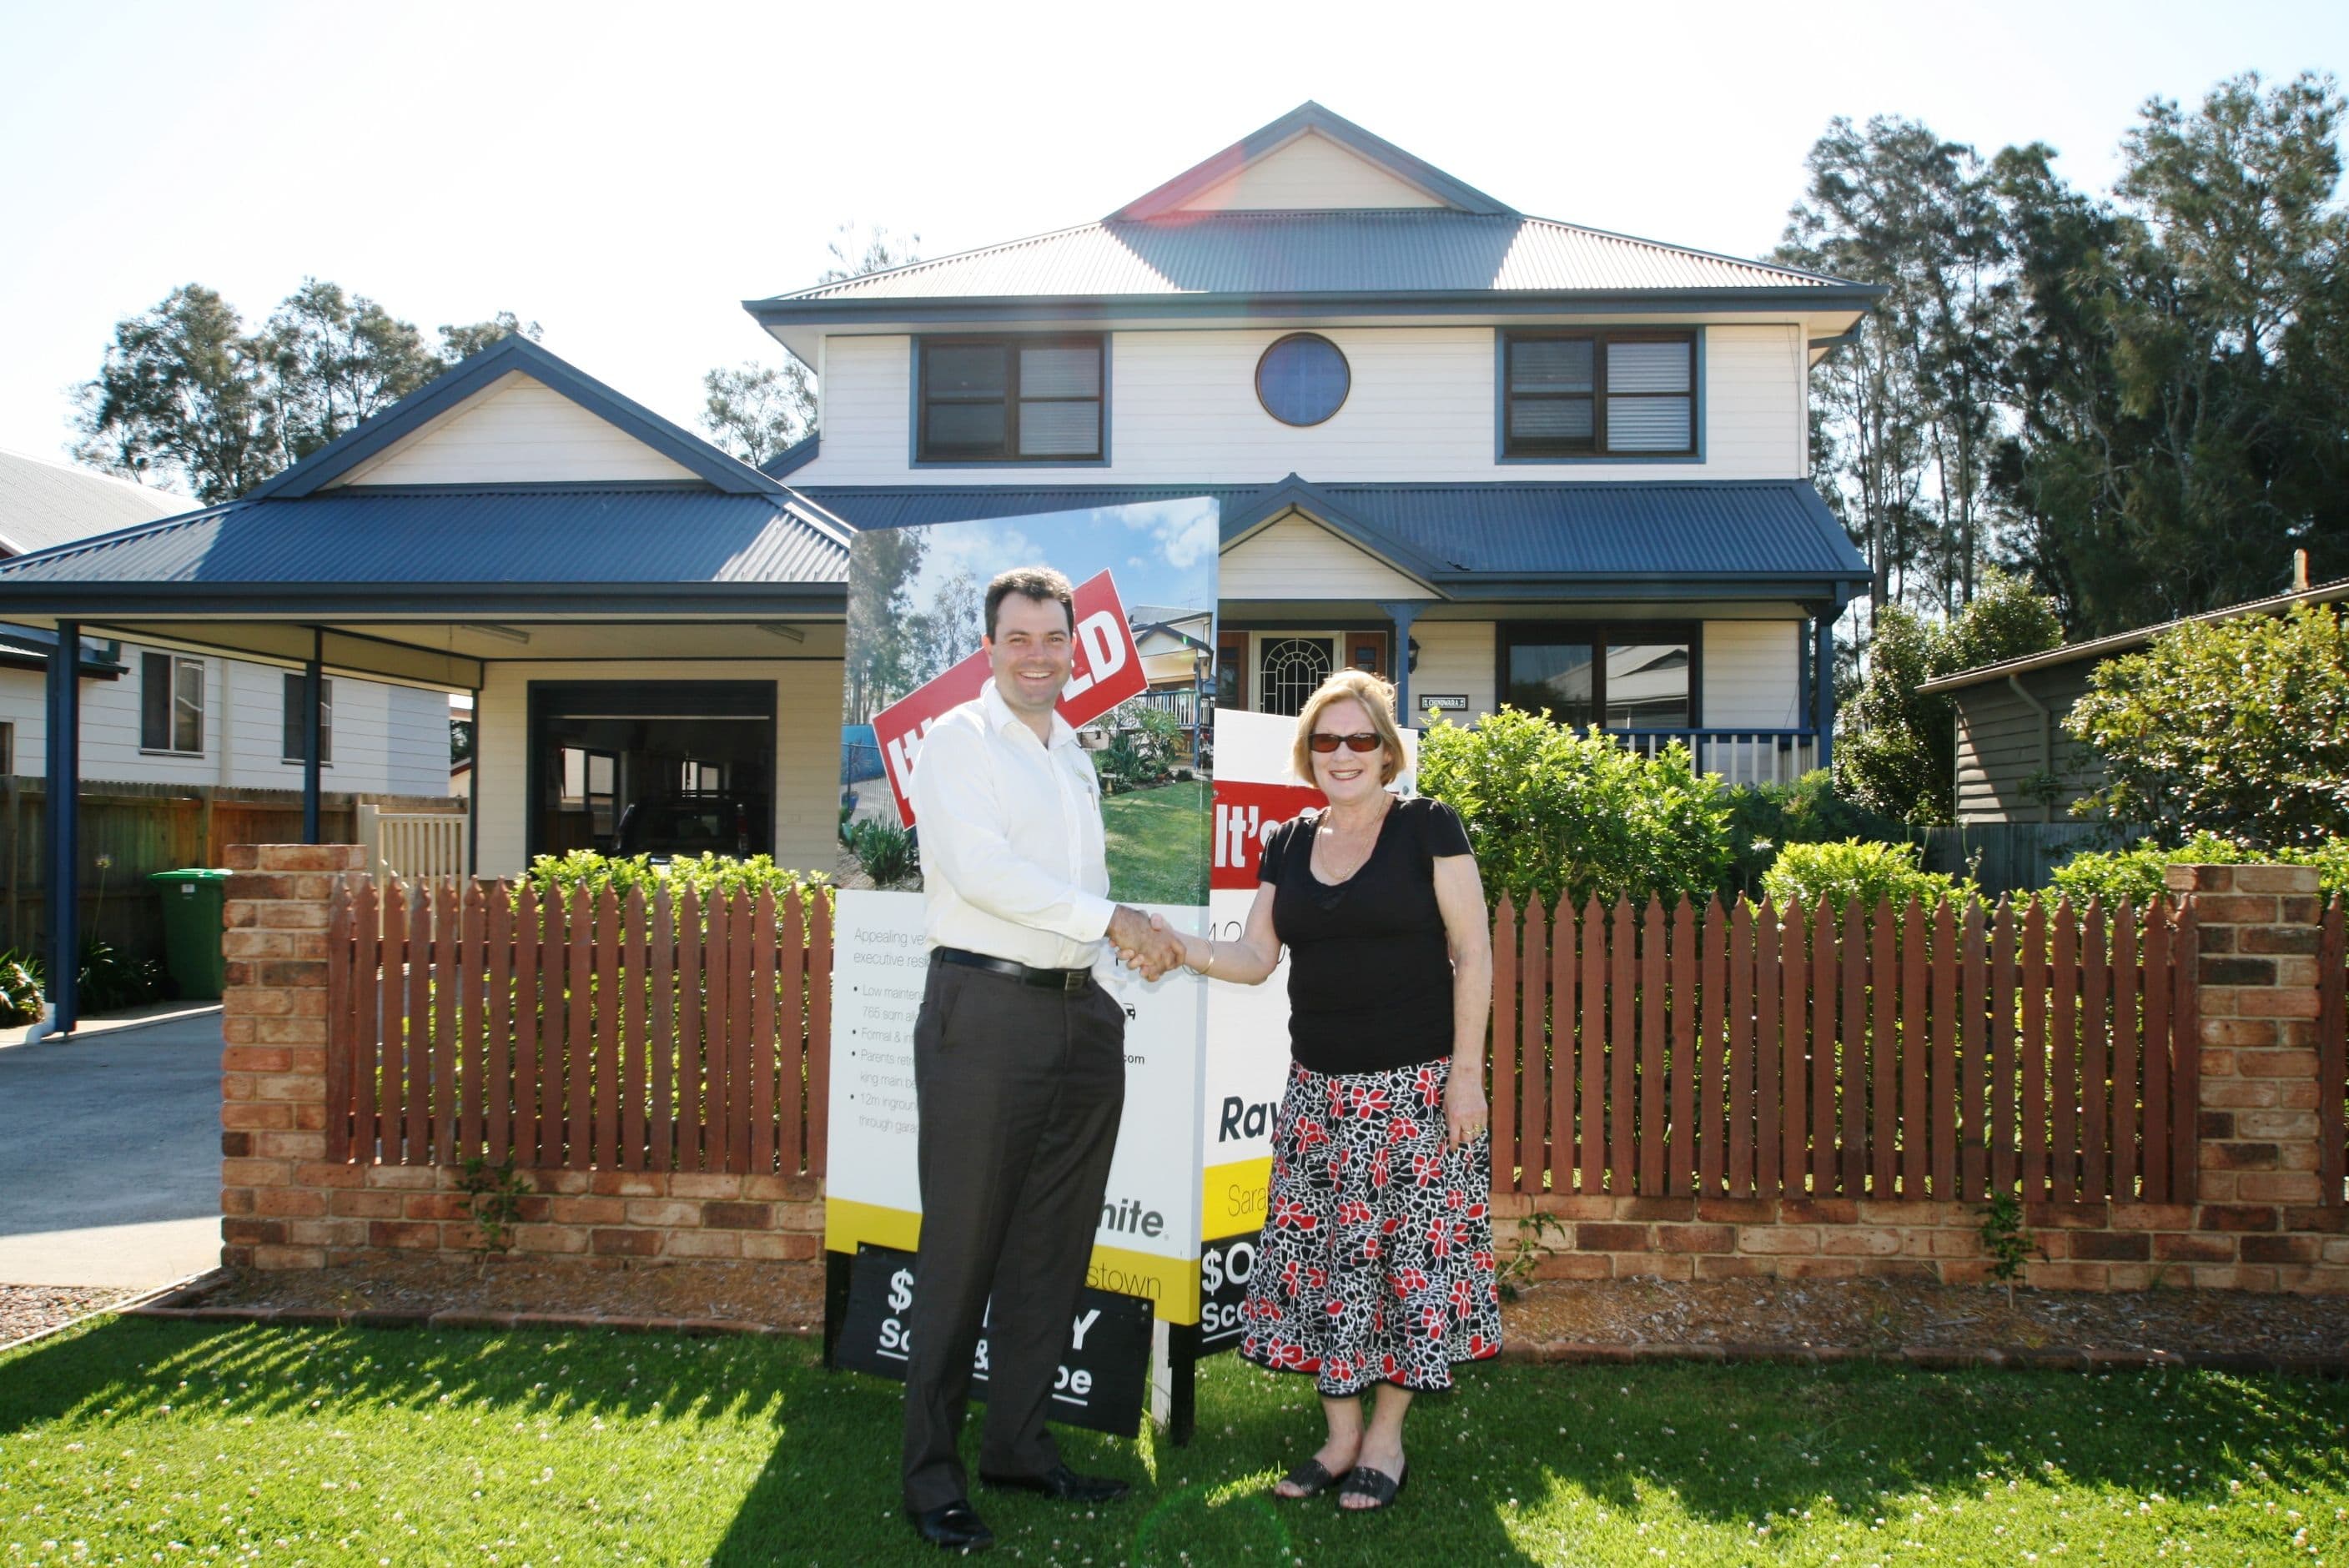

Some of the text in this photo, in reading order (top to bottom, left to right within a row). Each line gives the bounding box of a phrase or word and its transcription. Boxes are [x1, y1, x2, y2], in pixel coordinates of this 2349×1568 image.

[853, 927, 908, 947] Appealing
[853, 952, 905, 967] executive
[863, 984, 883, 997] Low
[883, 1009, 903, 1022] sqm
[861, 1027, 893, 1041] Formal
[893, 1030, 902, 1043] &
[860, 1048, 895, 1064] Parents
[859, 1070, 879, 1087] king
[881, 1072, 903, 1087] main
[860, 1093, 881, 1106] 12m
[859, 1113, 893, 1132] through
